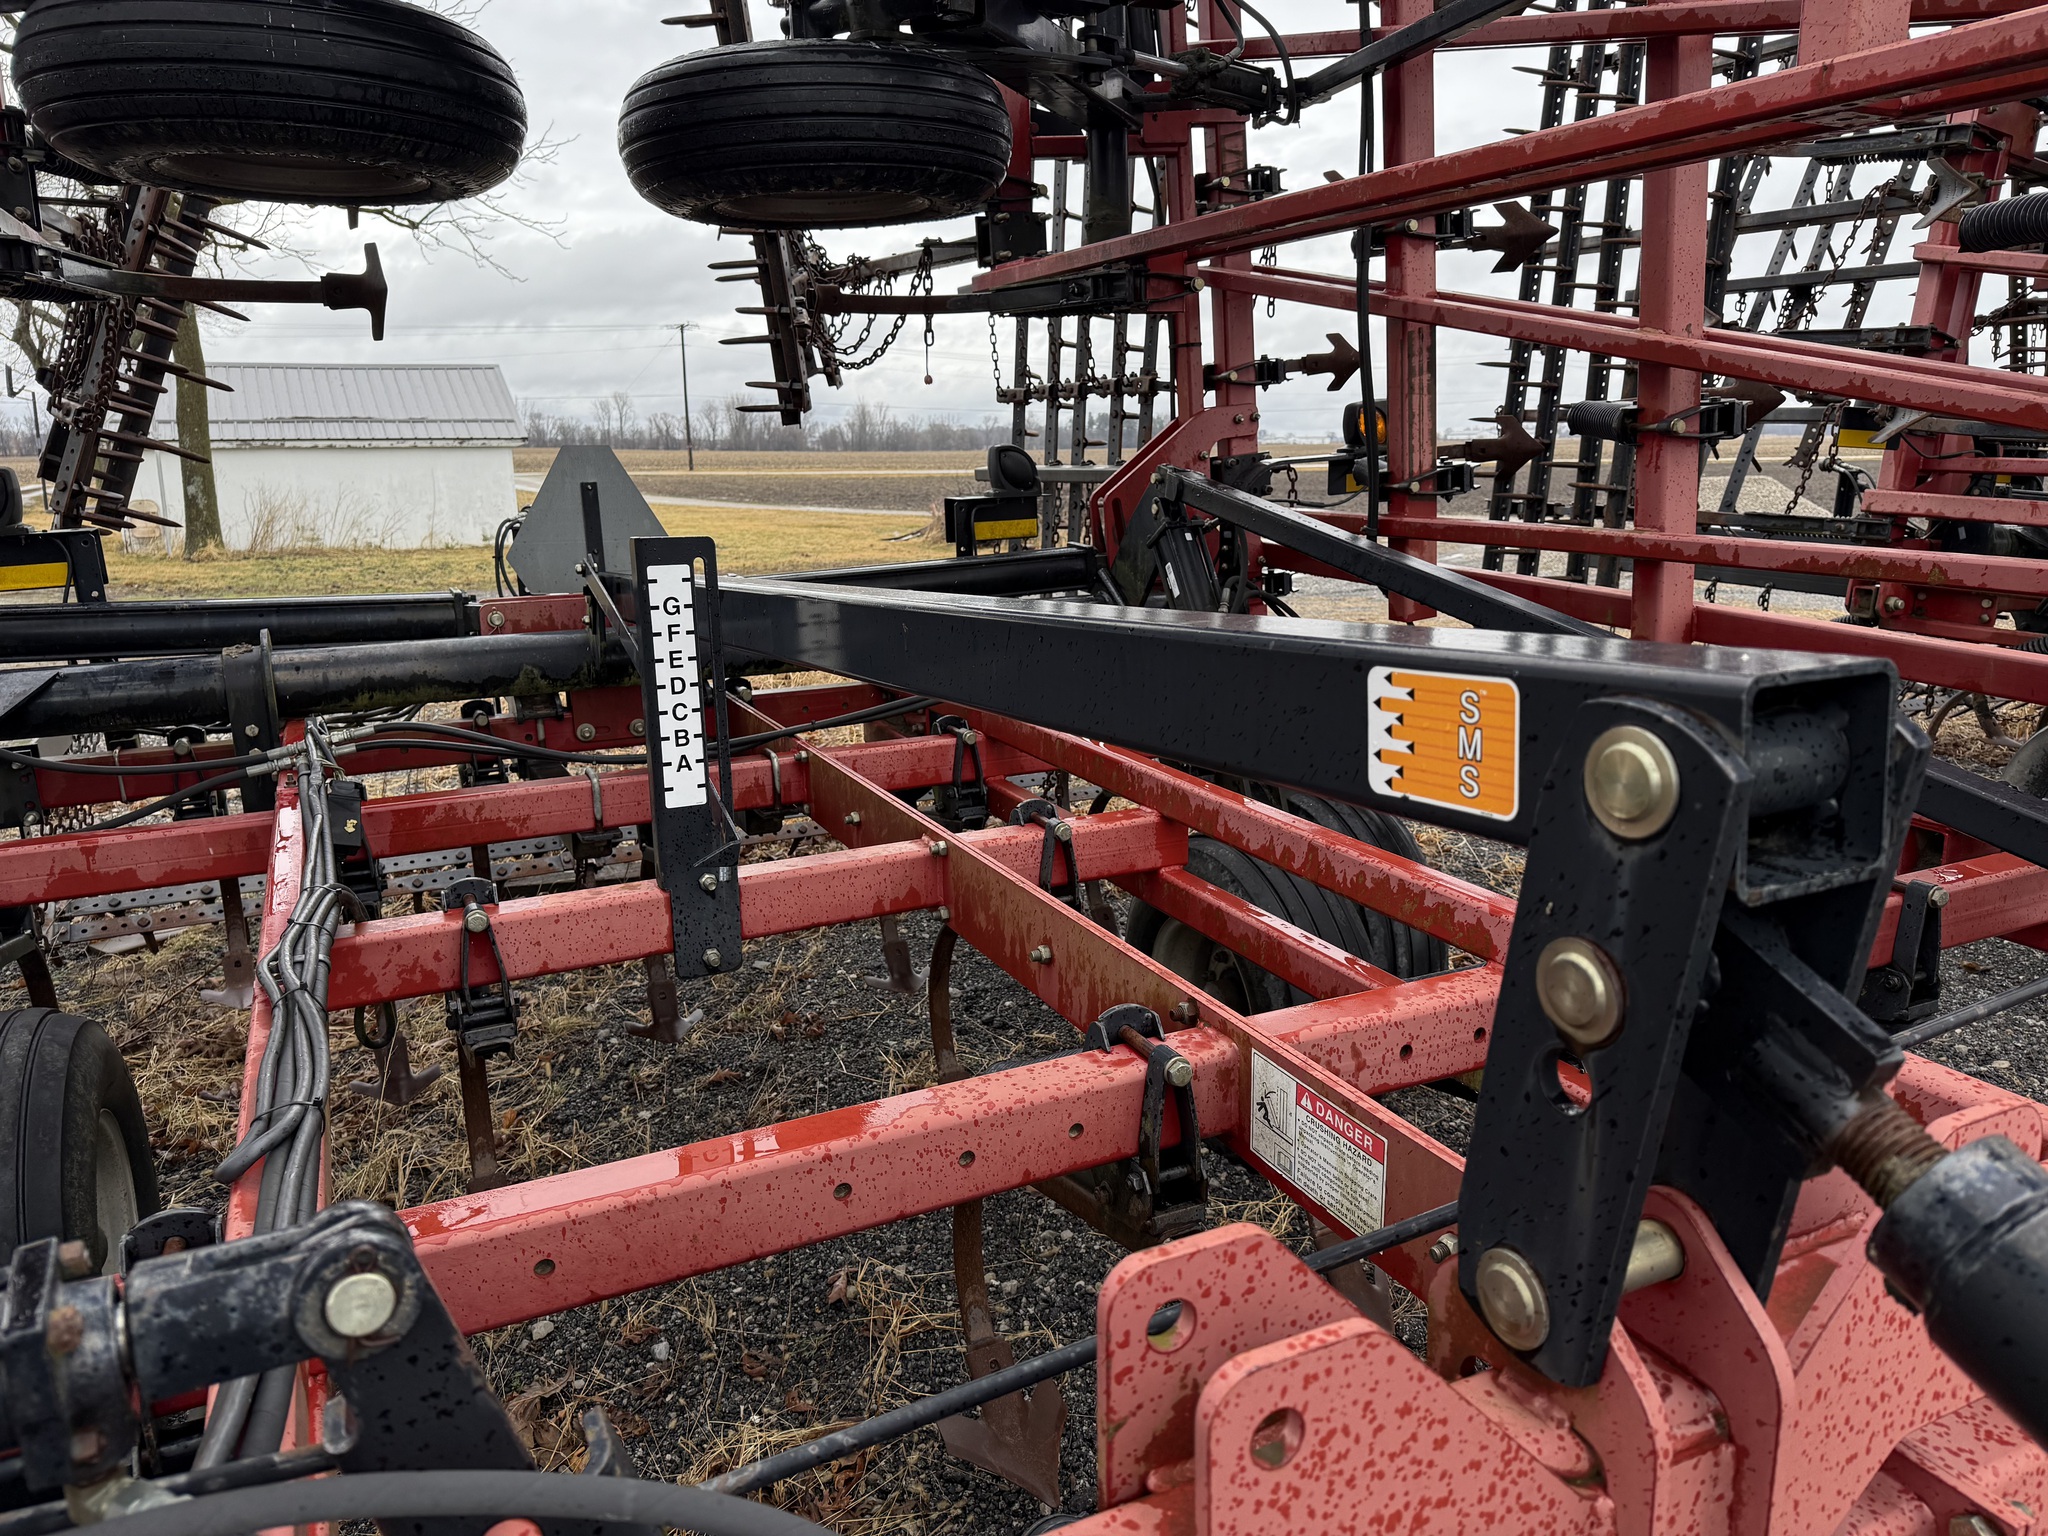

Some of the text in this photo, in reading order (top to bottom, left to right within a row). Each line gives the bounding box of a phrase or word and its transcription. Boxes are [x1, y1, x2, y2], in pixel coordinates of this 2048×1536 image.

[662, 596, 681, 616] G
[667, 623, 681, 642] F
[668, 650, 684, 669] E
[670, 676, 686, 695] D
[672, 702, 688, 722] C
[674, 729, 690, 747] B
[1458, 690, 1483, 799] SMS
[676, 754, 693, 772] A
[1315, 1100, 1373, 1152] DANGER
[1305, 1114, 1372, 1167] CRUSHING HAZARD
[1297, 1166, 1315, 1187] Failure
[1316, 1182, 1322, 1192] to
[1323, 1188, 1343, 1209] comply
[1345, 1204, 1355, 1218] will
[1303, 1179, 1318, 1197] death
[1326, 1198, 1347, 1220] serious
